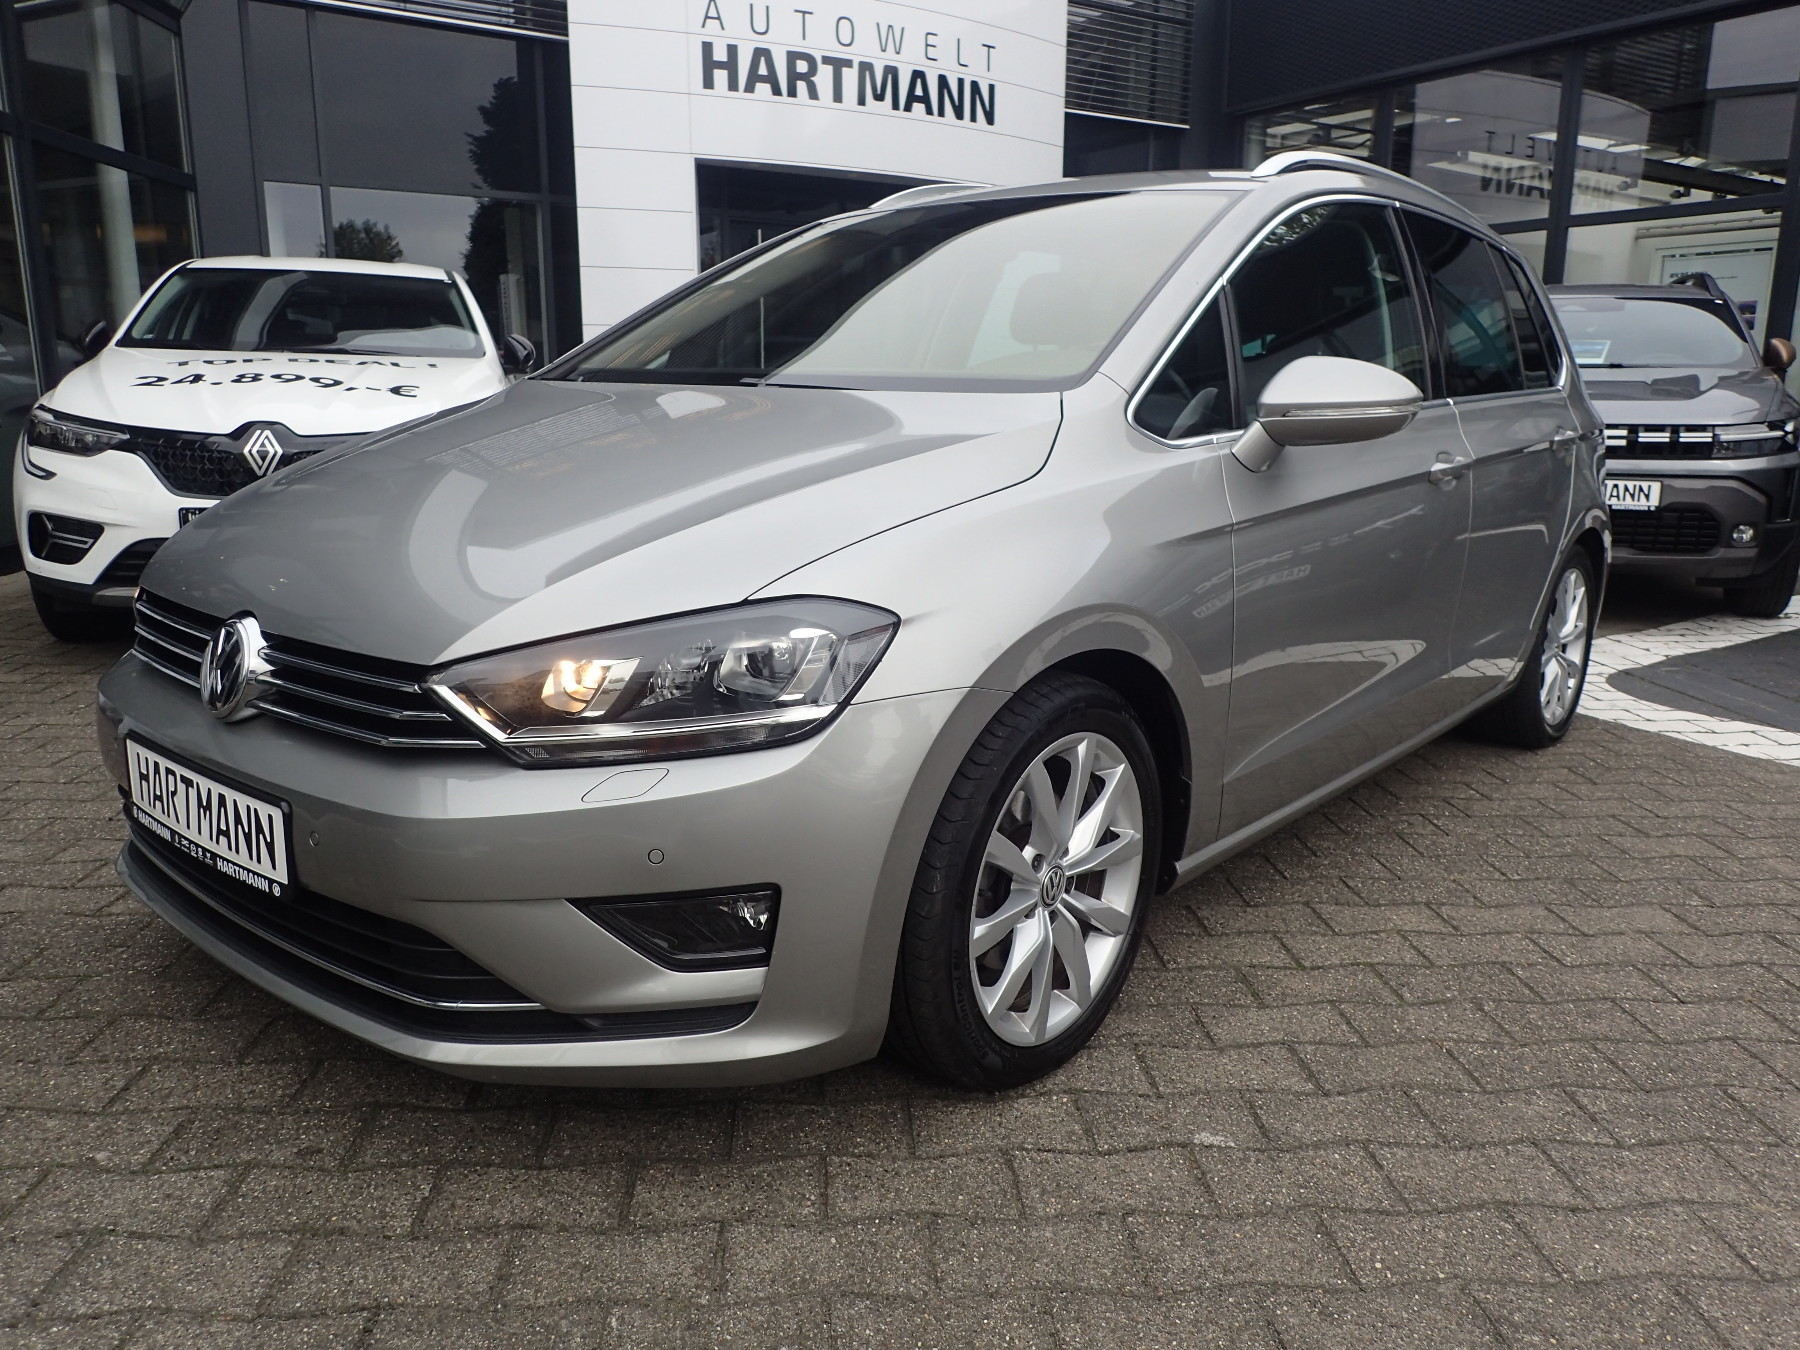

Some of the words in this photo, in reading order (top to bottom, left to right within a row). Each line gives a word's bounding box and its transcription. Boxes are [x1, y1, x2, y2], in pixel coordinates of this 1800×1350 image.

[701, 0, 996, 72] AUTOWELT
[701, 41, 995, 126] HARTMANN
[167, 358, 272, 367] TOP
[1604, 483, 1651, 502] ANN
[136, 752, 277, 871] HARTMANN
[138, 811, 171, 842] HARTMANN
[216, 857, 269, 893] HARTMANN
